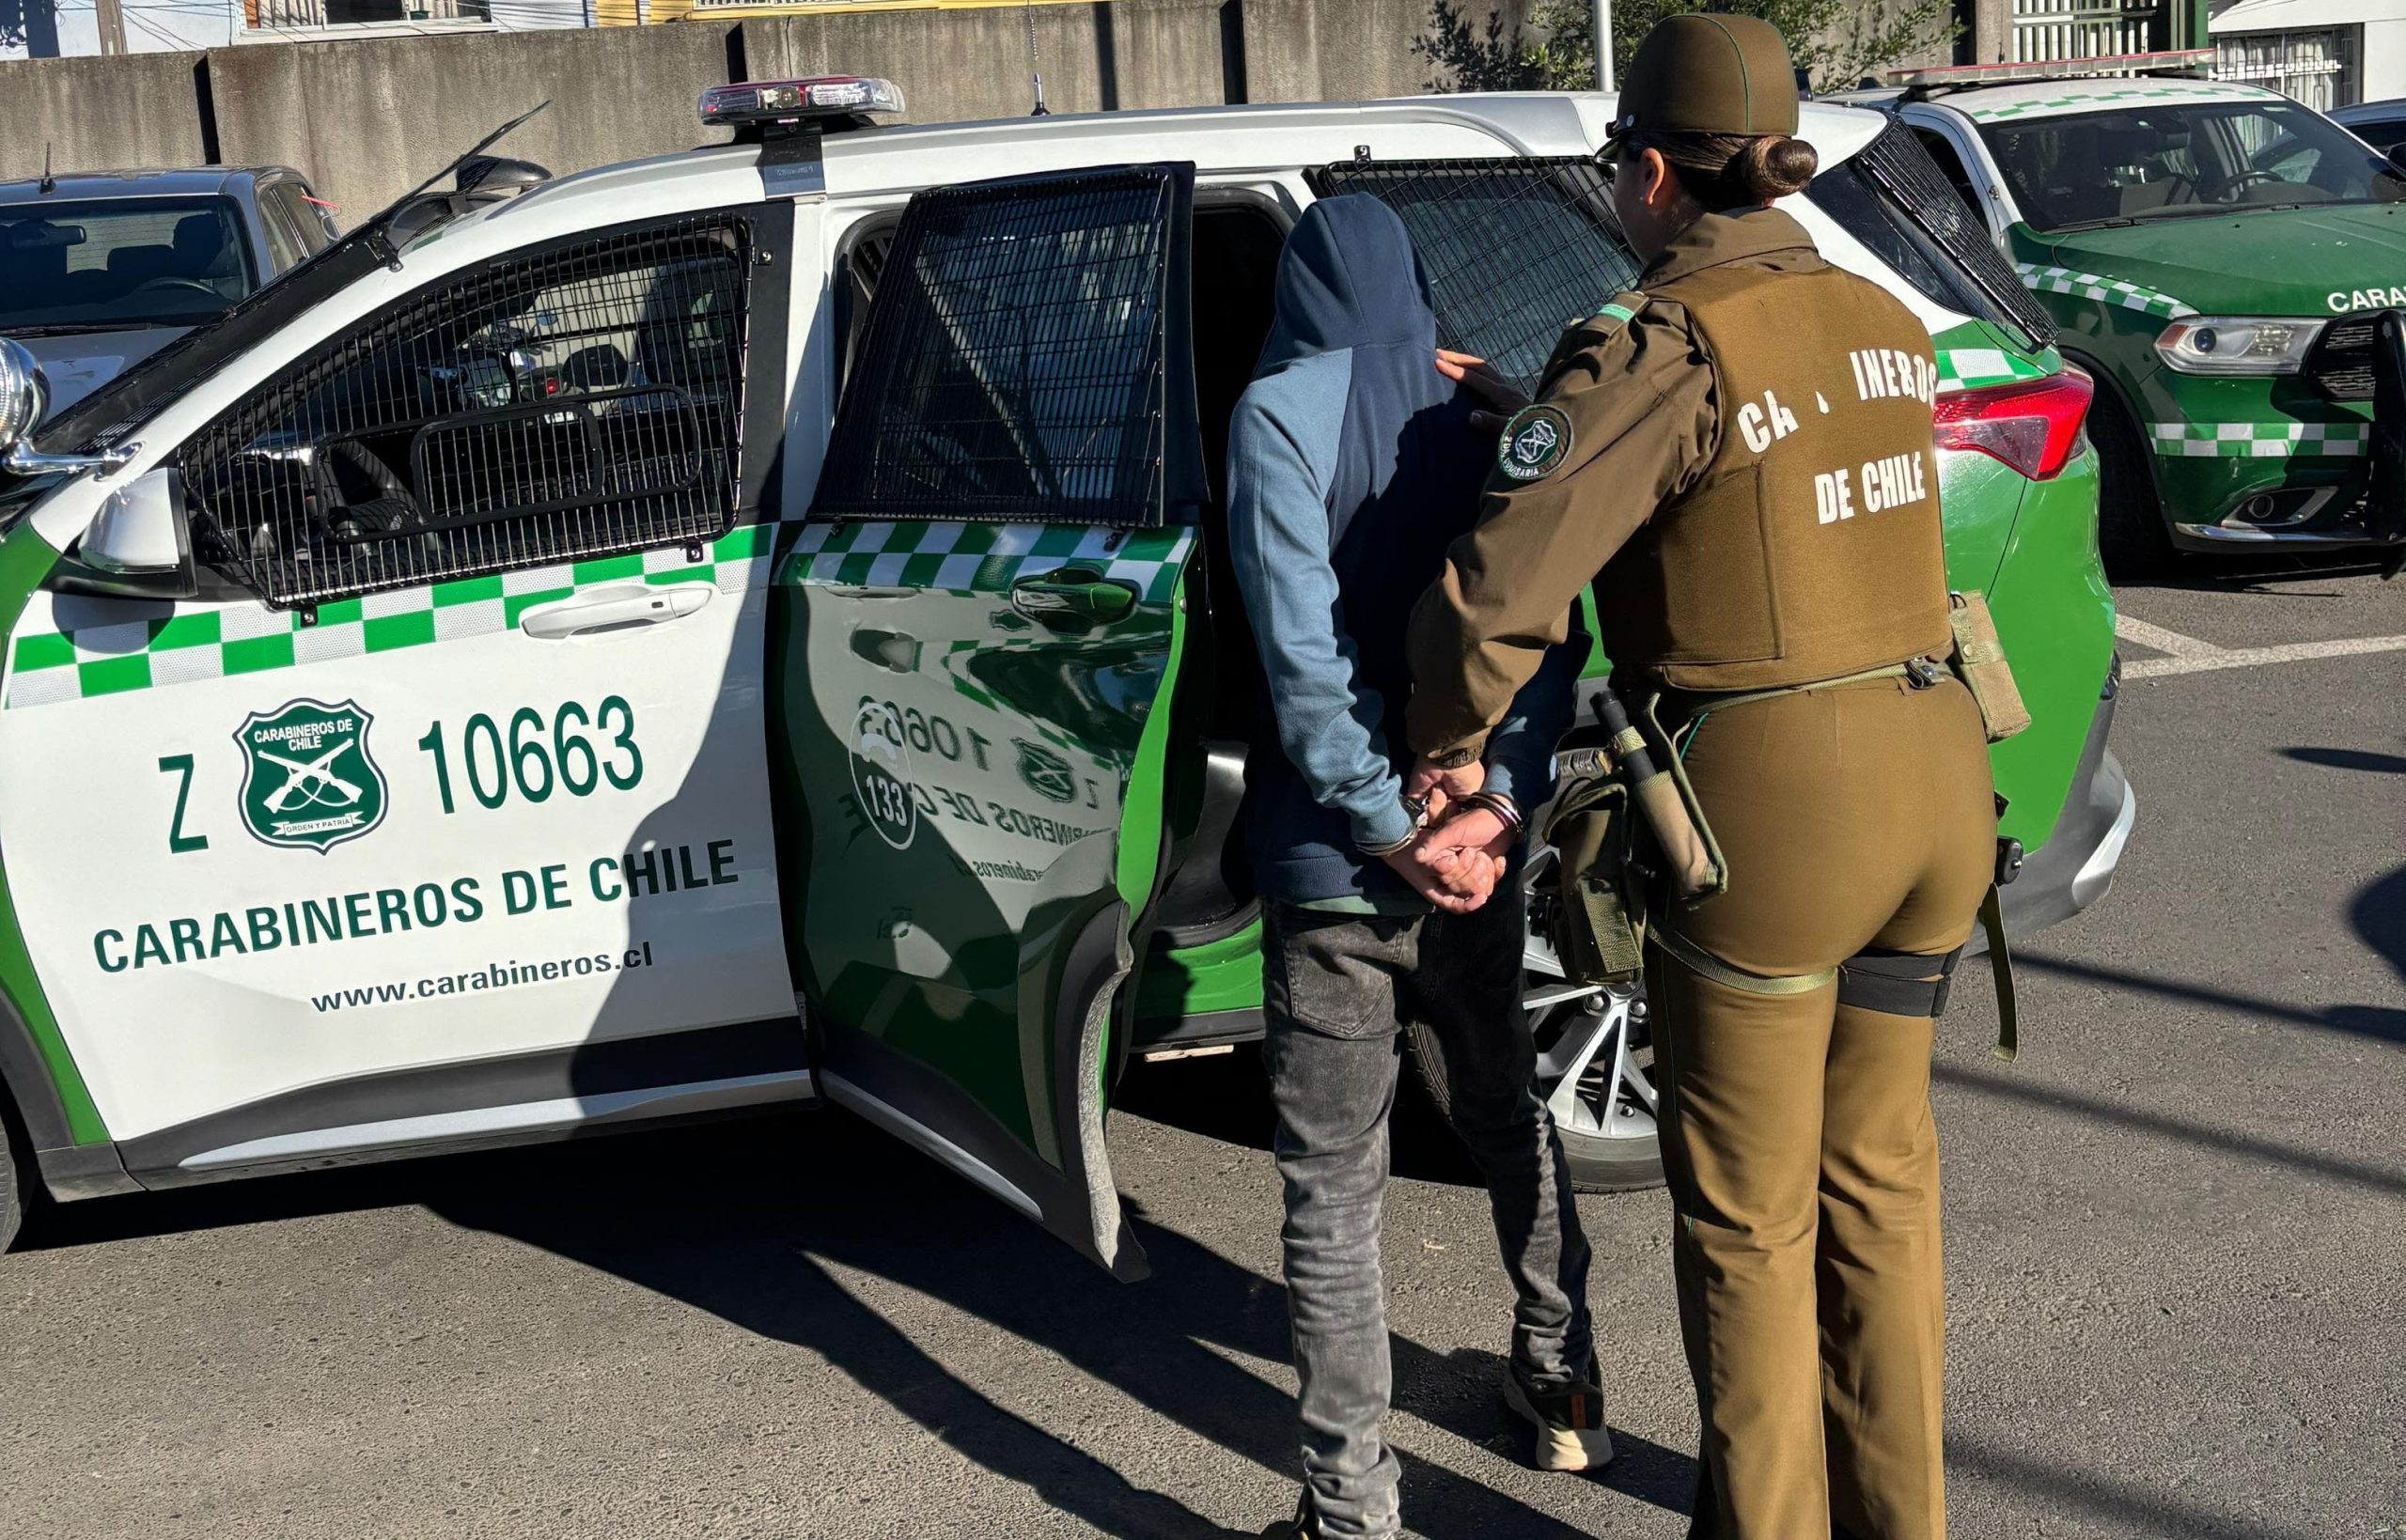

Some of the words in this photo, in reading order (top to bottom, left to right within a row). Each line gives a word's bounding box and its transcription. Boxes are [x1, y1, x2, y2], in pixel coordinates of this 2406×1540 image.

[2326, 286, 2406, 313] CARA
[1814, 468, 1855, 525] DE
[1861, 451, 1926, 513] CHILE
[254, 721, 336, 743] CARABINEROS
[336, 718, 354, 733] DE
[288, 735, 322, 752] CHILE
[158, 753, 209, 854] Z
[417, 694, 644, 815] 10663
[866, 774, 908, 828] 133
[286, 823, 314, 833] ORDEN
[322, 818, 352, 829] PATRIA
[93, 877, 484, 973] CARABINEROS
[501, 863, 573, 916] DE
[588, 838, 739, 902] CHILE
[311, 941, 653, 1013] www.carabineros.cl
